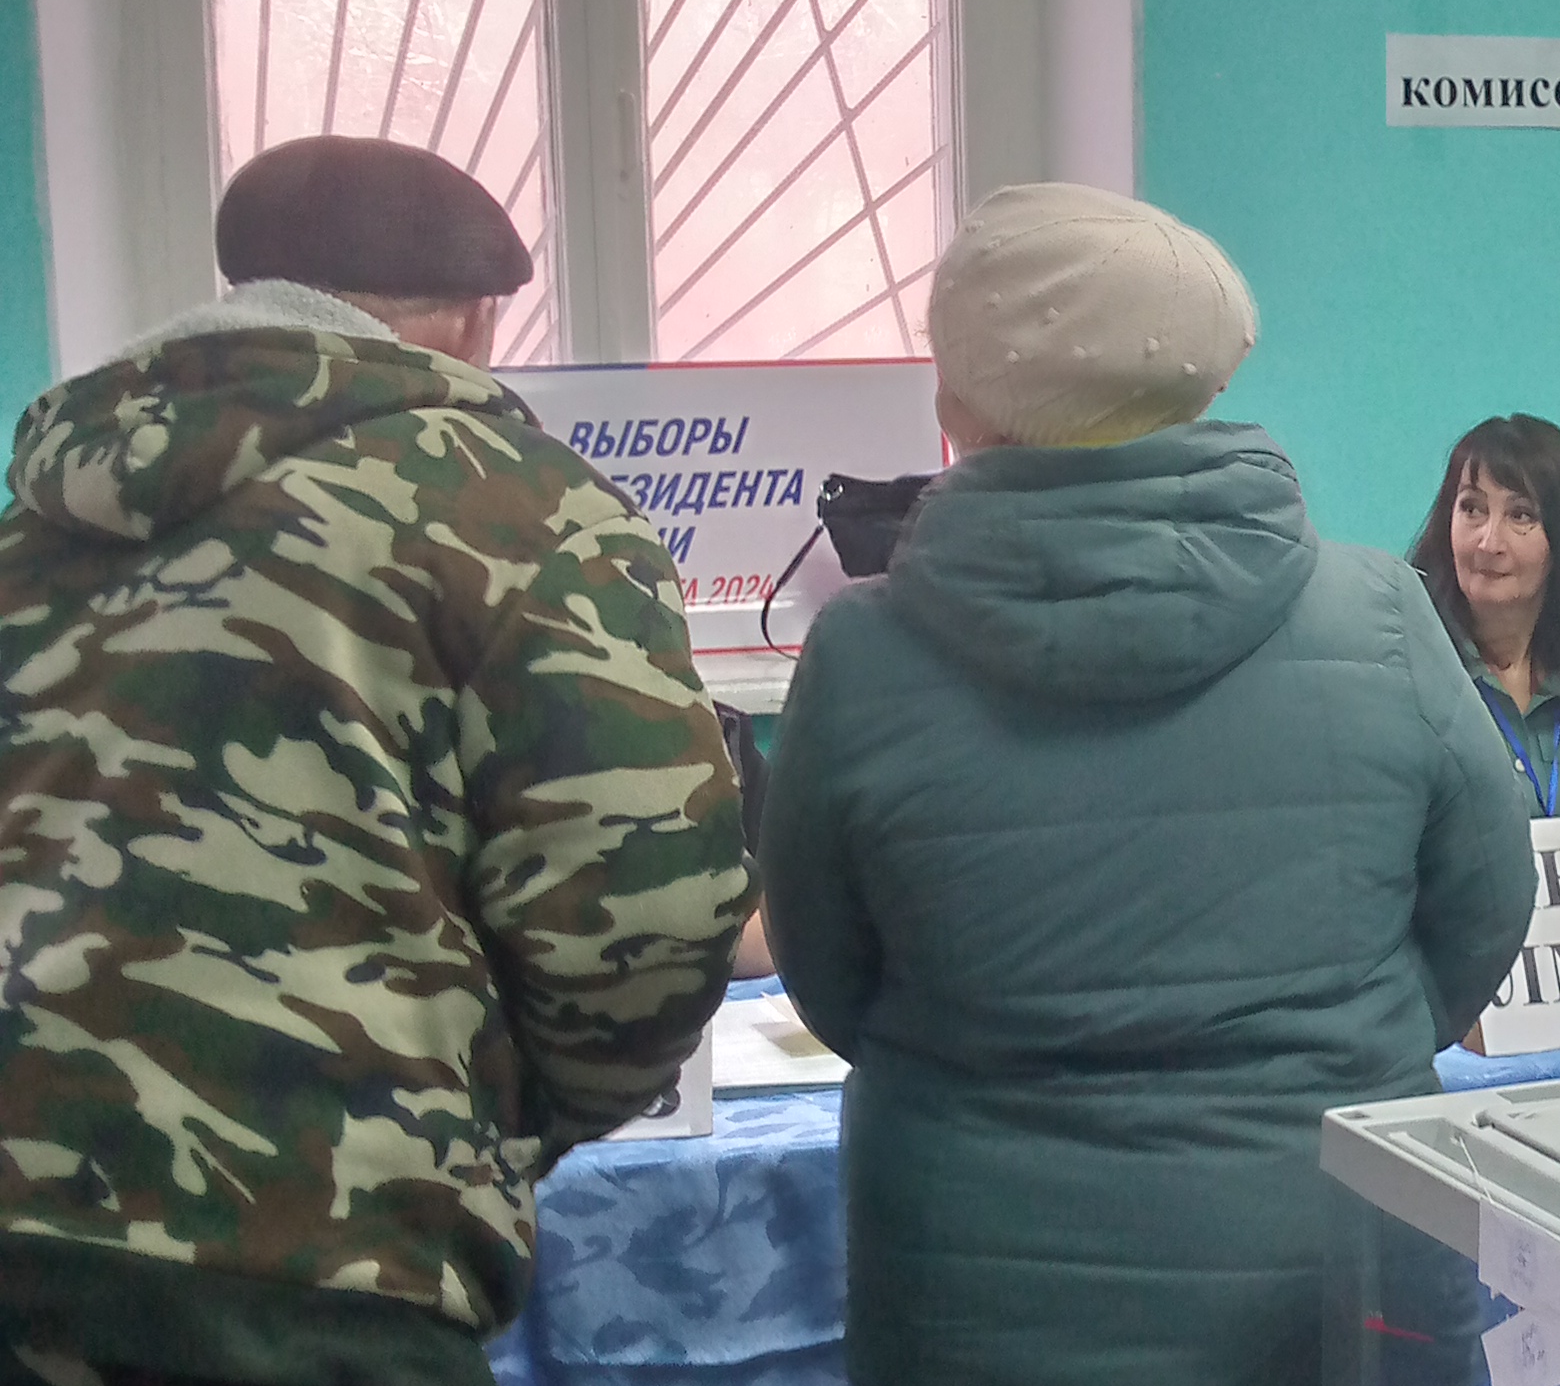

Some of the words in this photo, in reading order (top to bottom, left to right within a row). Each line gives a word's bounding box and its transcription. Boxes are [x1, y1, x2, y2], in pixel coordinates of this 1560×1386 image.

[569, 416, 750, 458] ВЫБОРЫ
[611, 468, 804, 516] ЗИДЕНТА
[706, 573, 774, 606] 2024
